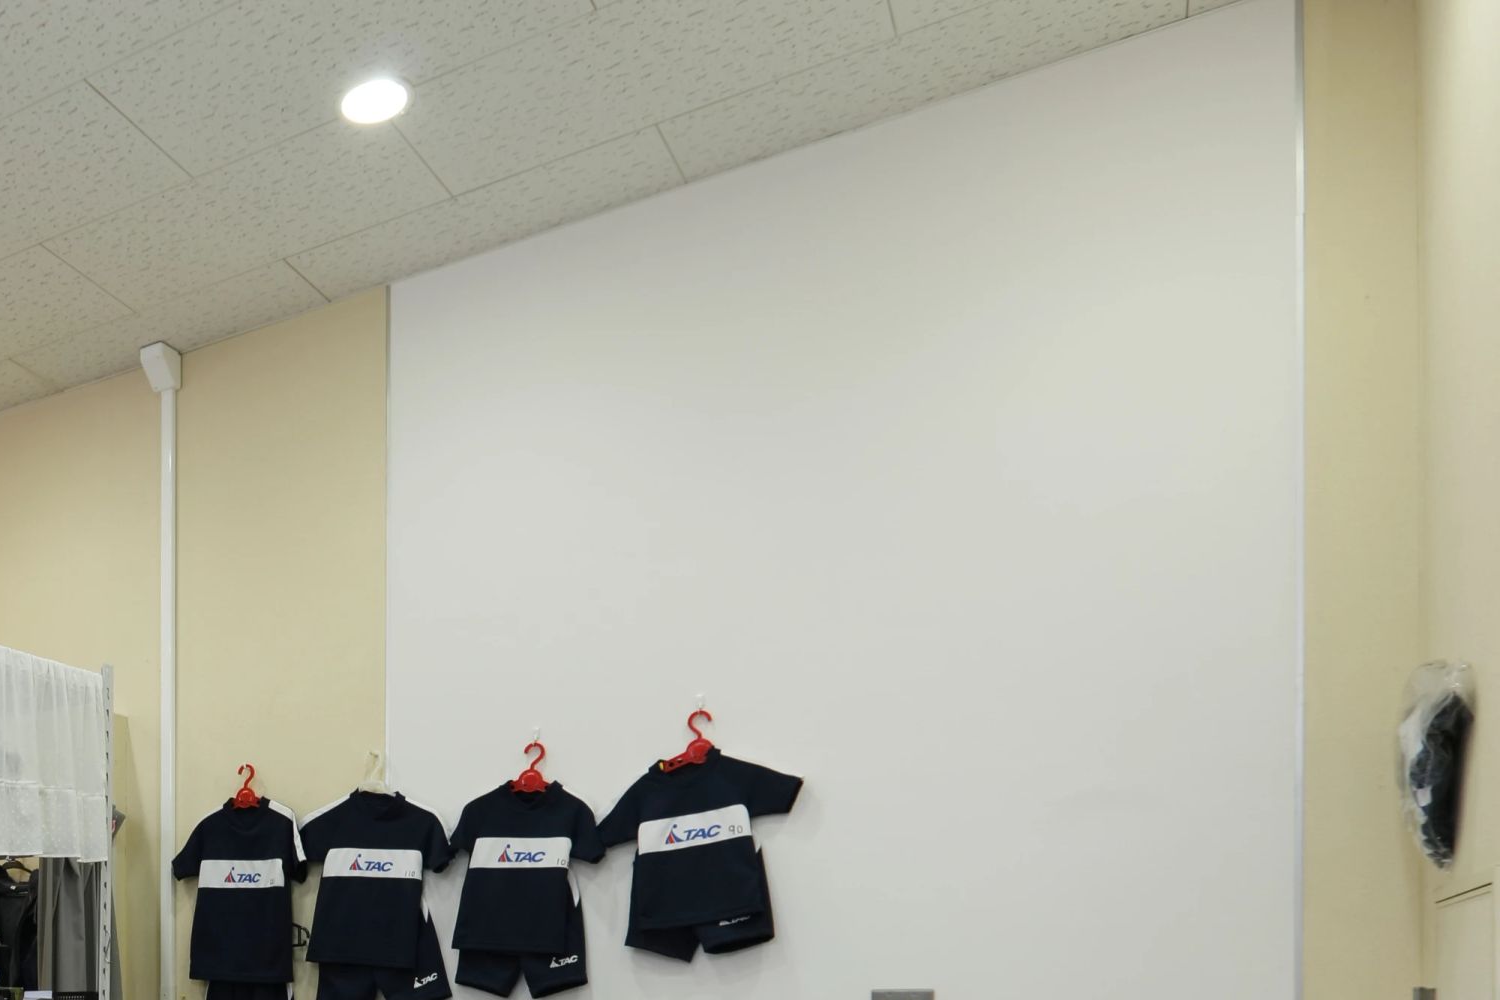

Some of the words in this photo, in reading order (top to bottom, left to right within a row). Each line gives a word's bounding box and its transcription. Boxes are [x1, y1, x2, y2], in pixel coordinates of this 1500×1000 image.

[683, 824, 721, 841] TAC
[728, 824, 744, 835] 90
[513, 851, 546, 863] TAC
[363, 861, 393, 872] TAC
[236, 873, 262, 883] TAC
[559, 955, 578, 966] TAC
[420, 972, 438, 985] TAC
